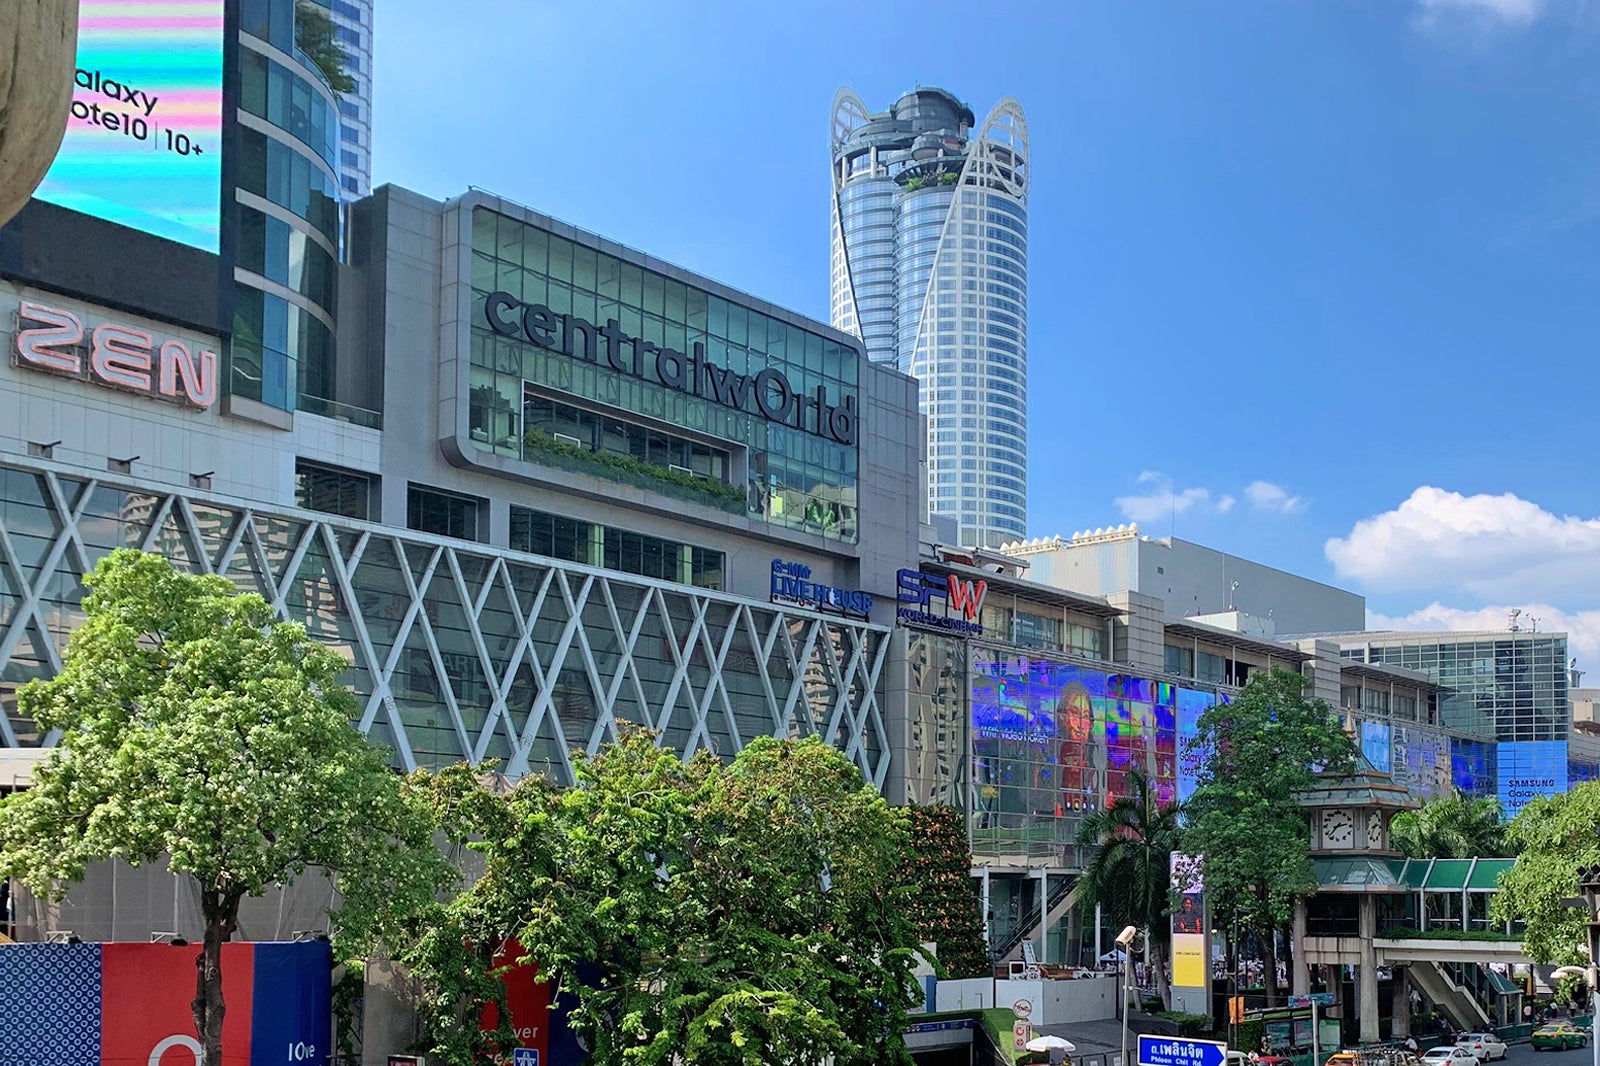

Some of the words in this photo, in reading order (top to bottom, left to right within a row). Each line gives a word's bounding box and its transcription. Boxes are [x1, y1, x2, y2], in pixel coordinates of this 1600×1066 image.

[74, 69, 158, 117] alaxy
[71, 100, 147, 141] ote10
[17, 300, 217, 407] ZEN
[772, 572, 811, 601] LIVE
[1508, 779, 1554, 788] SAMSUNG
[1151, 1041, 1204, 1059] ถ.เพลินจิต
